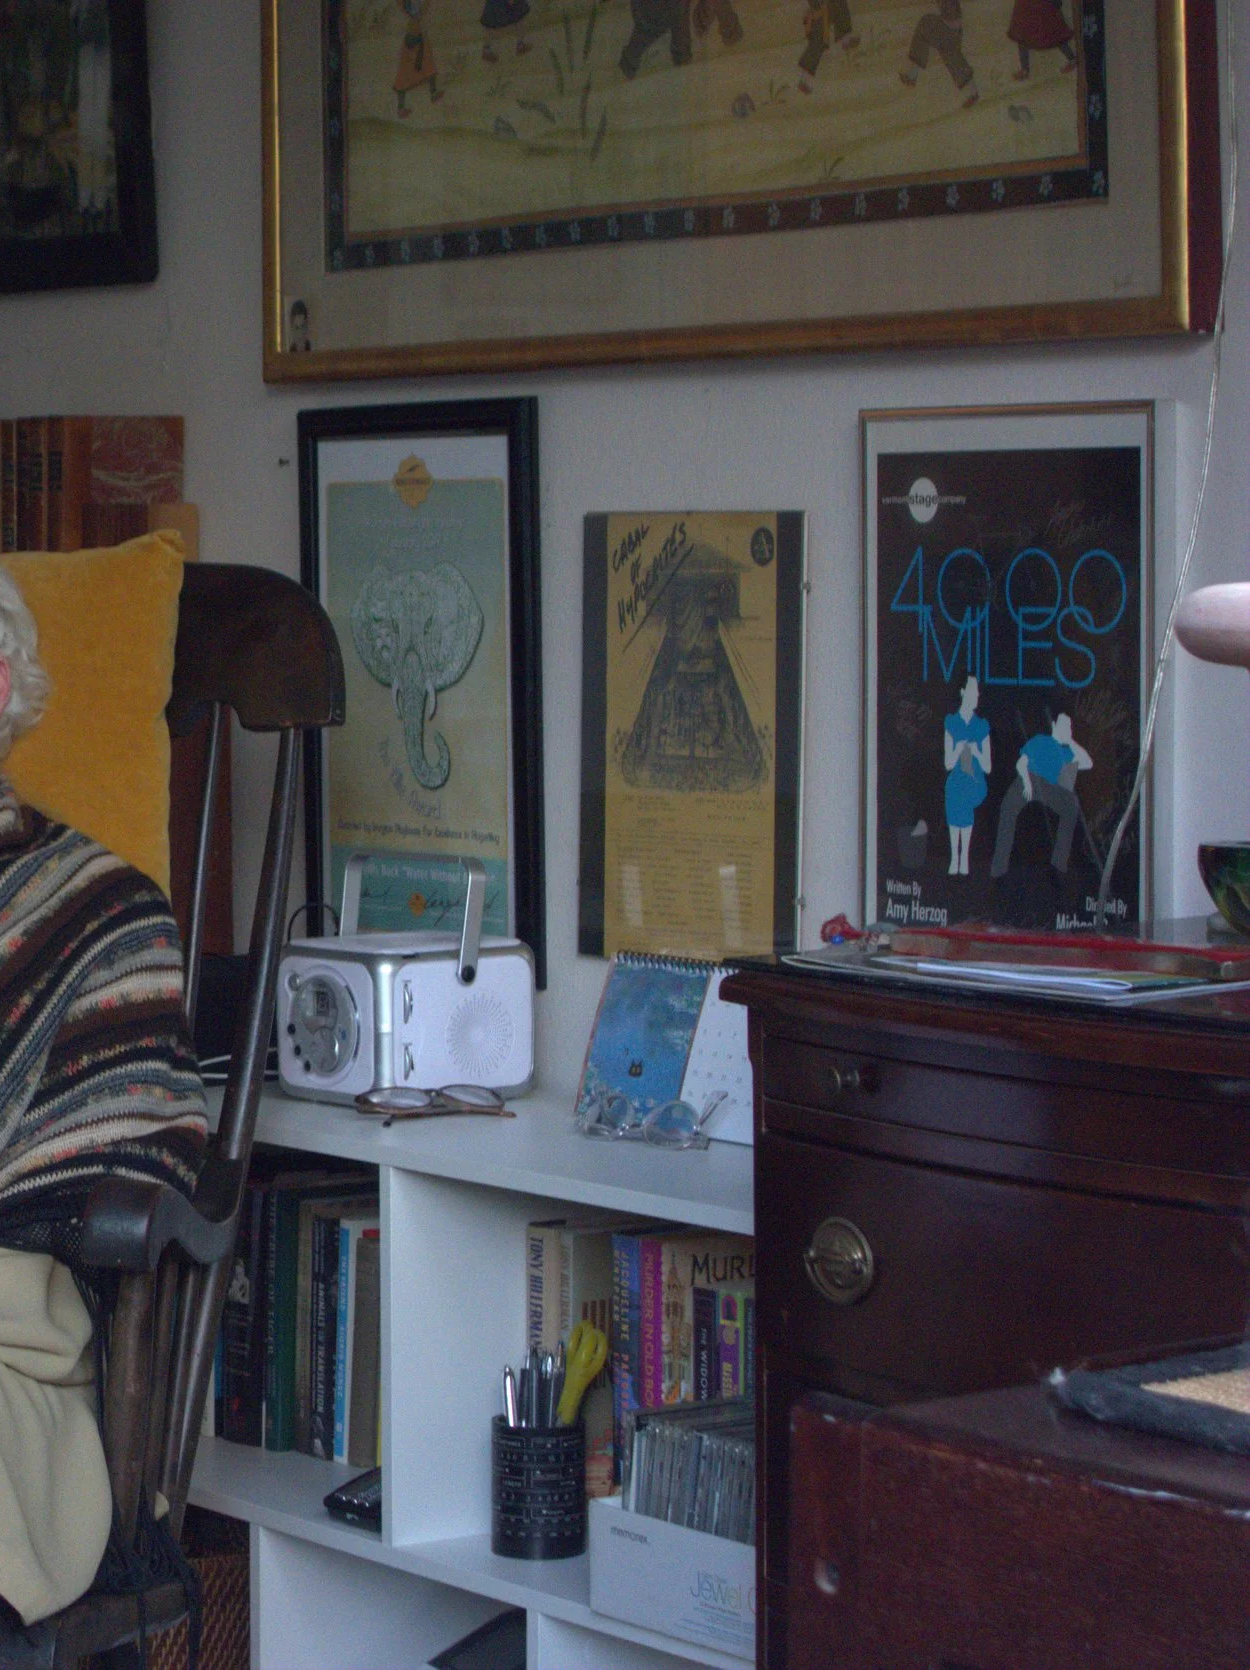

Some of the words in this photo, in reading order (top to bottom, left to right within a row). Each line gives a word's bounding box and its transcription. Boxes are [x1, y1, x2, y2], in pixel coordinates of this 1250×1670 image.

[909, 493, 938, 509] stage
[612, 522, 650, 573] CABAL
[630, 553, 642, 586] OF
[889, 545, 1128, 635] 4000
[921, 604, 1097, 688] MILES
[886, 879, 912, 895] Written
[912, 882, 922, 899] By
[886, 899, 908, 924] Amy
[910, 901, 948, 928] Herzog
[1117, 898, 1128, 920] By
[529, 1236, 545, 1272] TONY
[619, 1250, 630, 1342] JACQUELINE
[644, 1253, 656, 1319] MURDER
[316, 1282, 327, 1328] ANIMALS
[644, 1322, 655, 1340] IN
[644, 1342, 655, 1377] OLD
[315, 1345, 327, 1413] TRANSLATION
